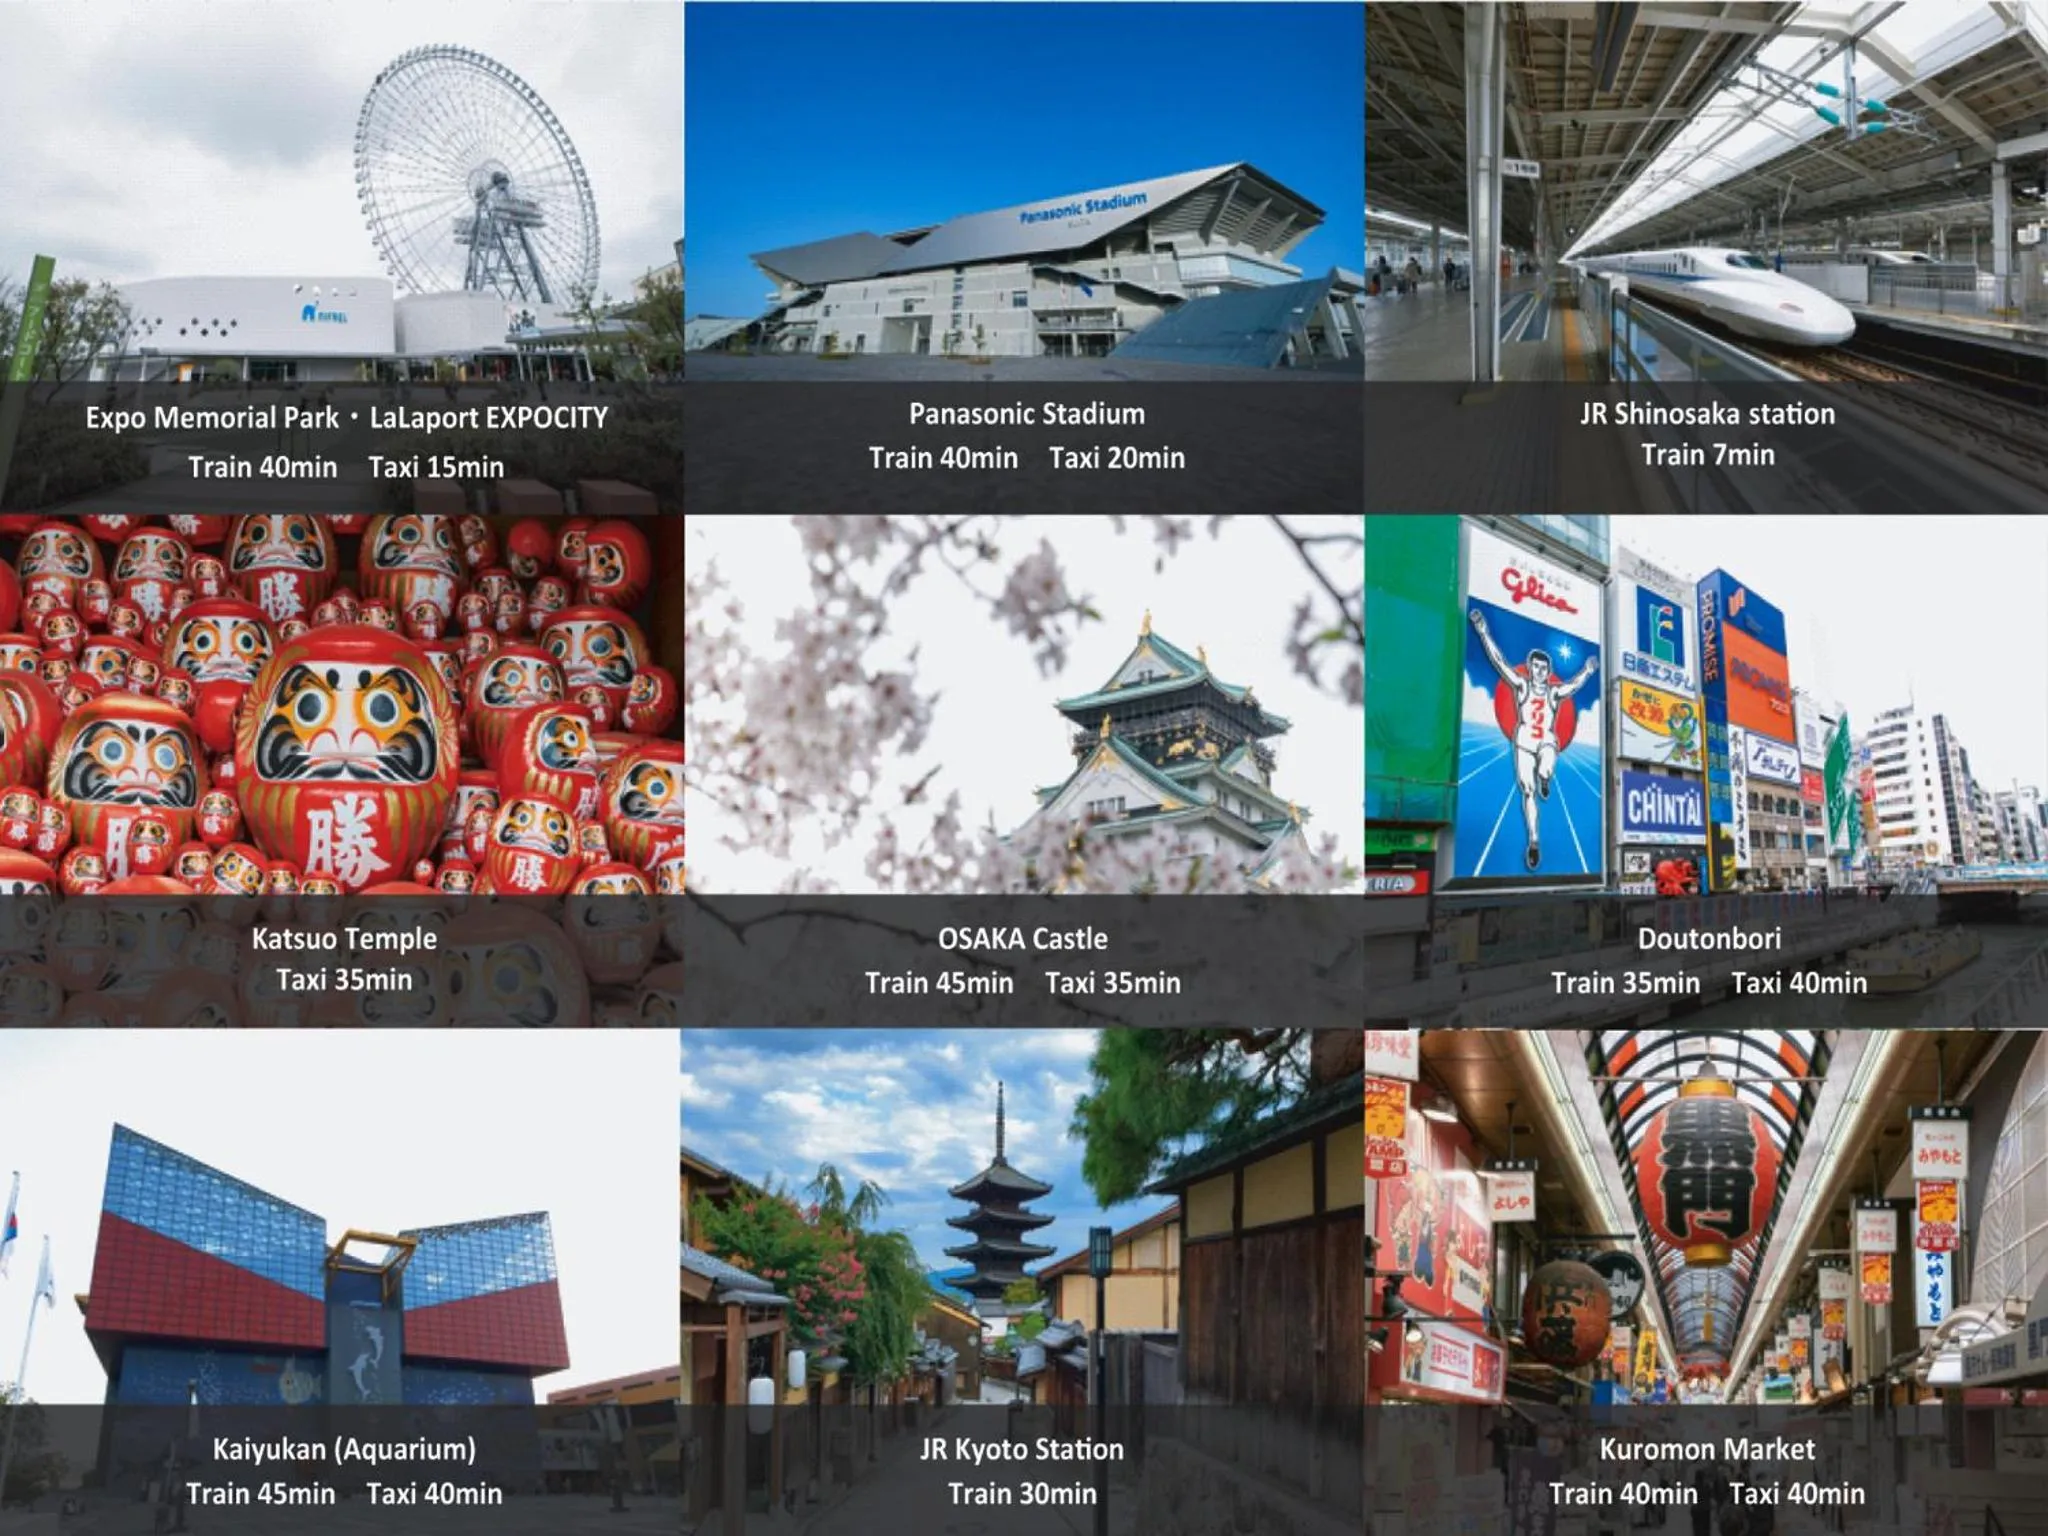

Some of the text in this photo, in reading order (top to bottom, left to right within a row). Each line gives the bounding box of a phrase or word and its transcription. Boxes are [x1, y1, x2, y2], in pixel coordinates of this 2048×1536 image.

[1020, 203, 1083, 224] Panasonic
[1085, 192, 1147, 214] Stadium
[259, 571, 304, 622] 勝
[1501, 567, 1578, 615] Glico
[1703, 589, 1719, 682] PROMISE
[1628, 783, 1703, 828] CHINTAI
[304, 791, 392, 888] 勝
[1919, 1149, 1962, 1164] みやもと
[1494, 1195, 1530, 1210] よしや
